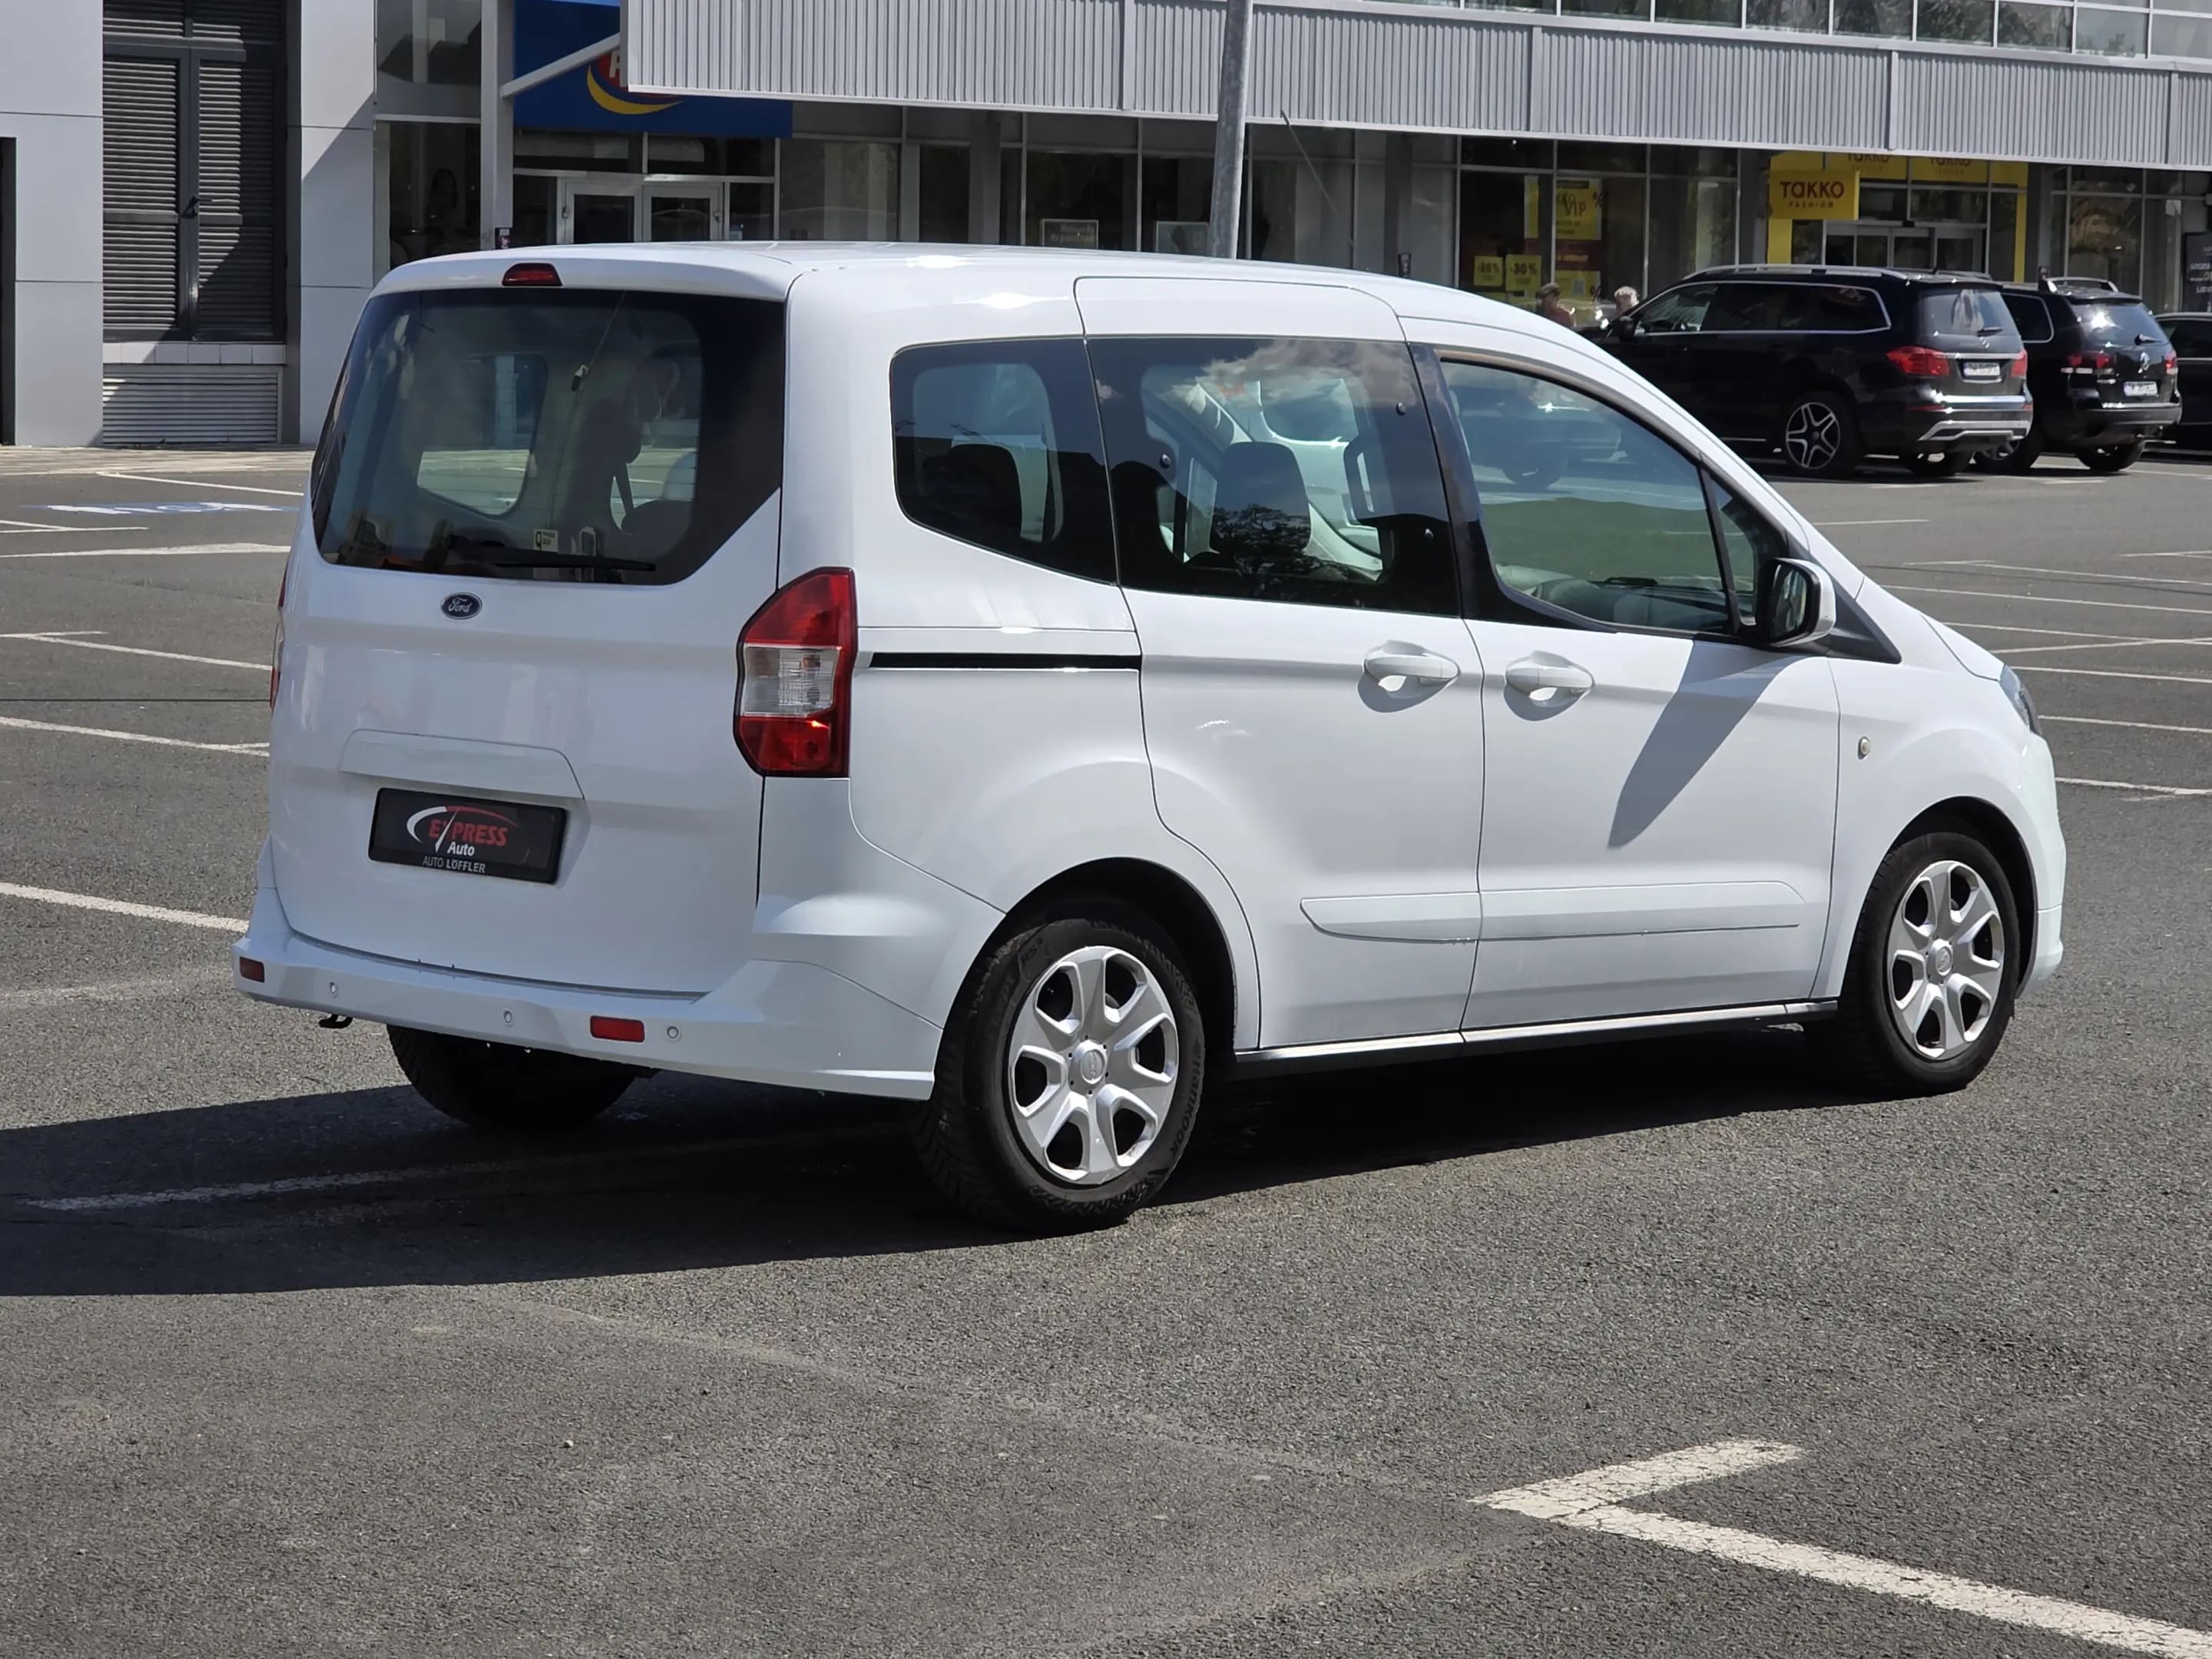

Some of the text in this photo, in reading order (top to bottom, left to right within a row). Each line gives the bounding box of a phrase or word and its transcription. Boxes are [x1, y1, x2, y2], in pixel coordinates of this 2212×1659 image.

[448, 597, 473, 613] Ford
[447, 841, 475, 856] Auto
[422, 856, 486, 873] AUTO LÖFFLER
